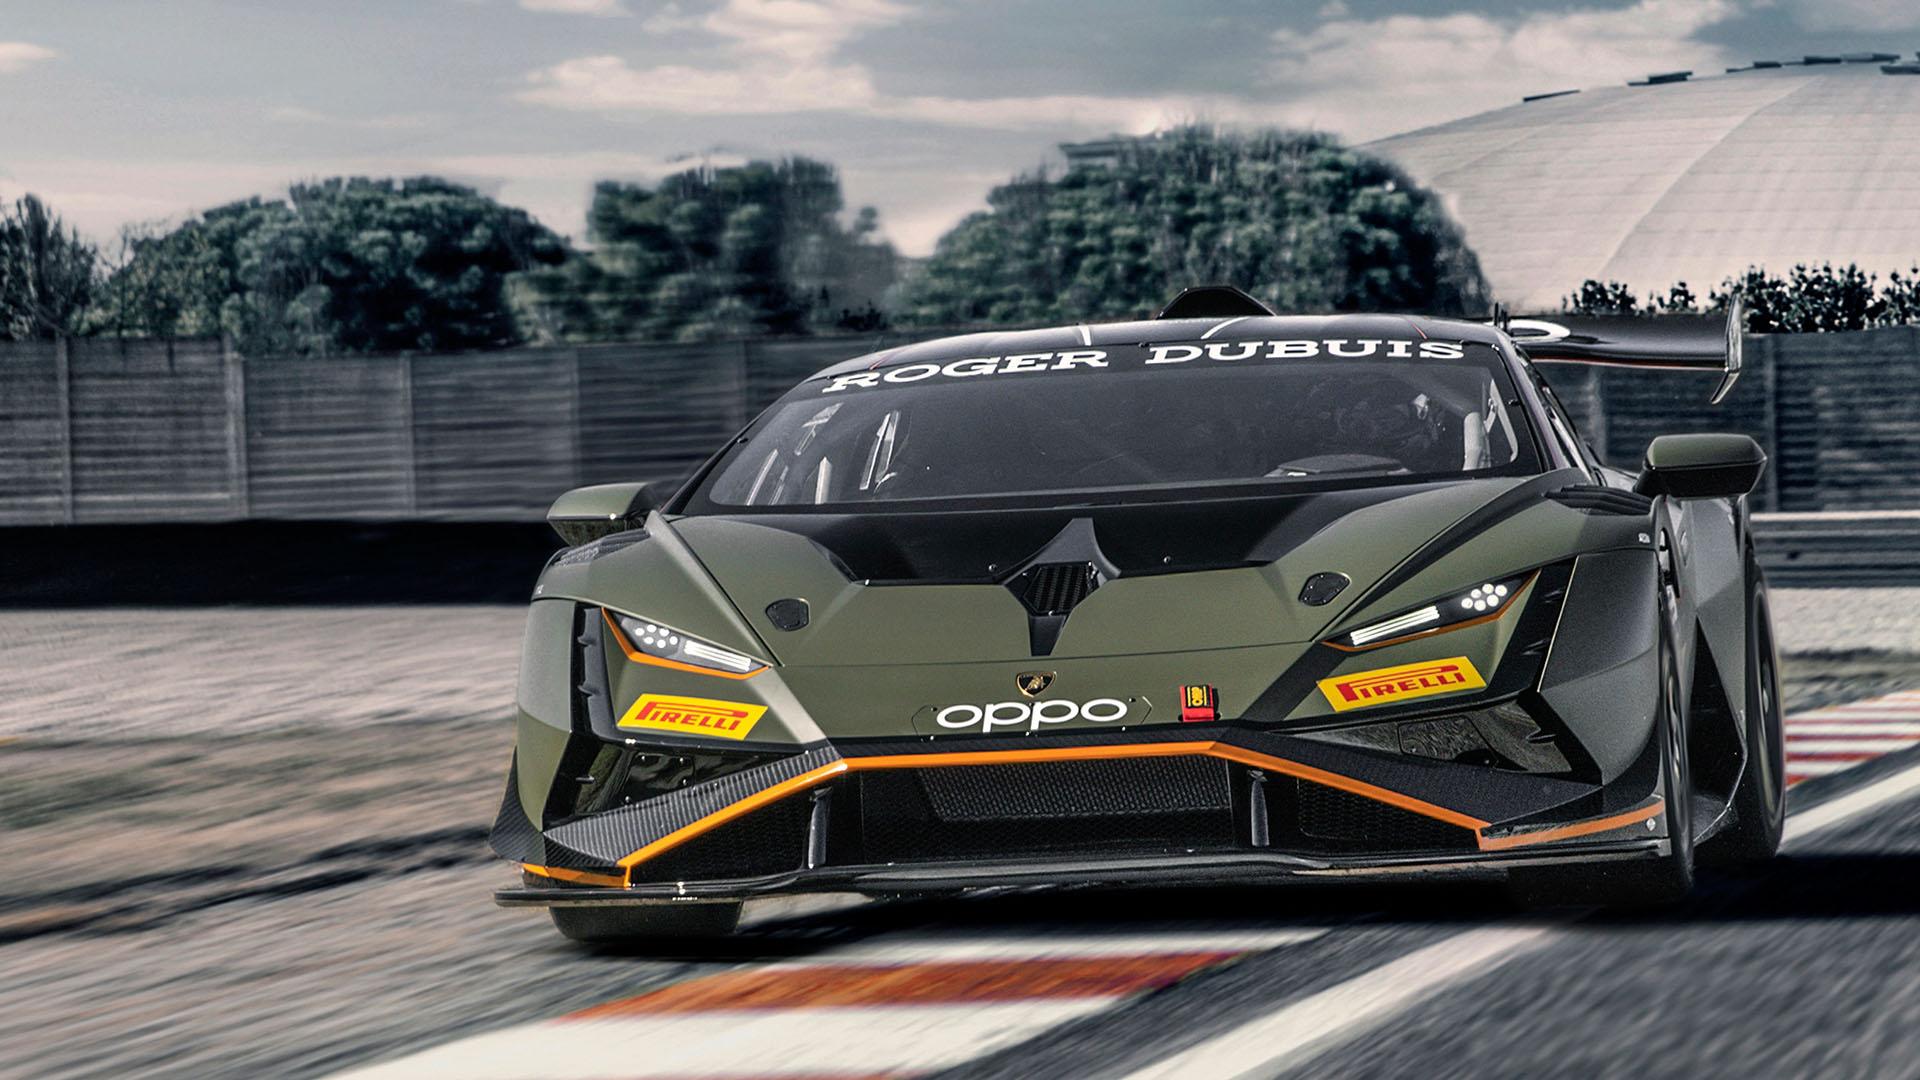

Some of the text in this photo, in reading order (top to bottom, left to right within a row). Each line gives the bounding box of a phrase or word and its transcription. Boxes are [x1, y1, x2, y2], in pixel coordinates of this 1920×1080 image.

[822, 339, 1464, 394] ROGER DUBUIS
[1335, 664, 1466, 703] PIRELLI
[635, 701, 749, 731] PIRELLI
[936, 698, 1128, 733] oppo
